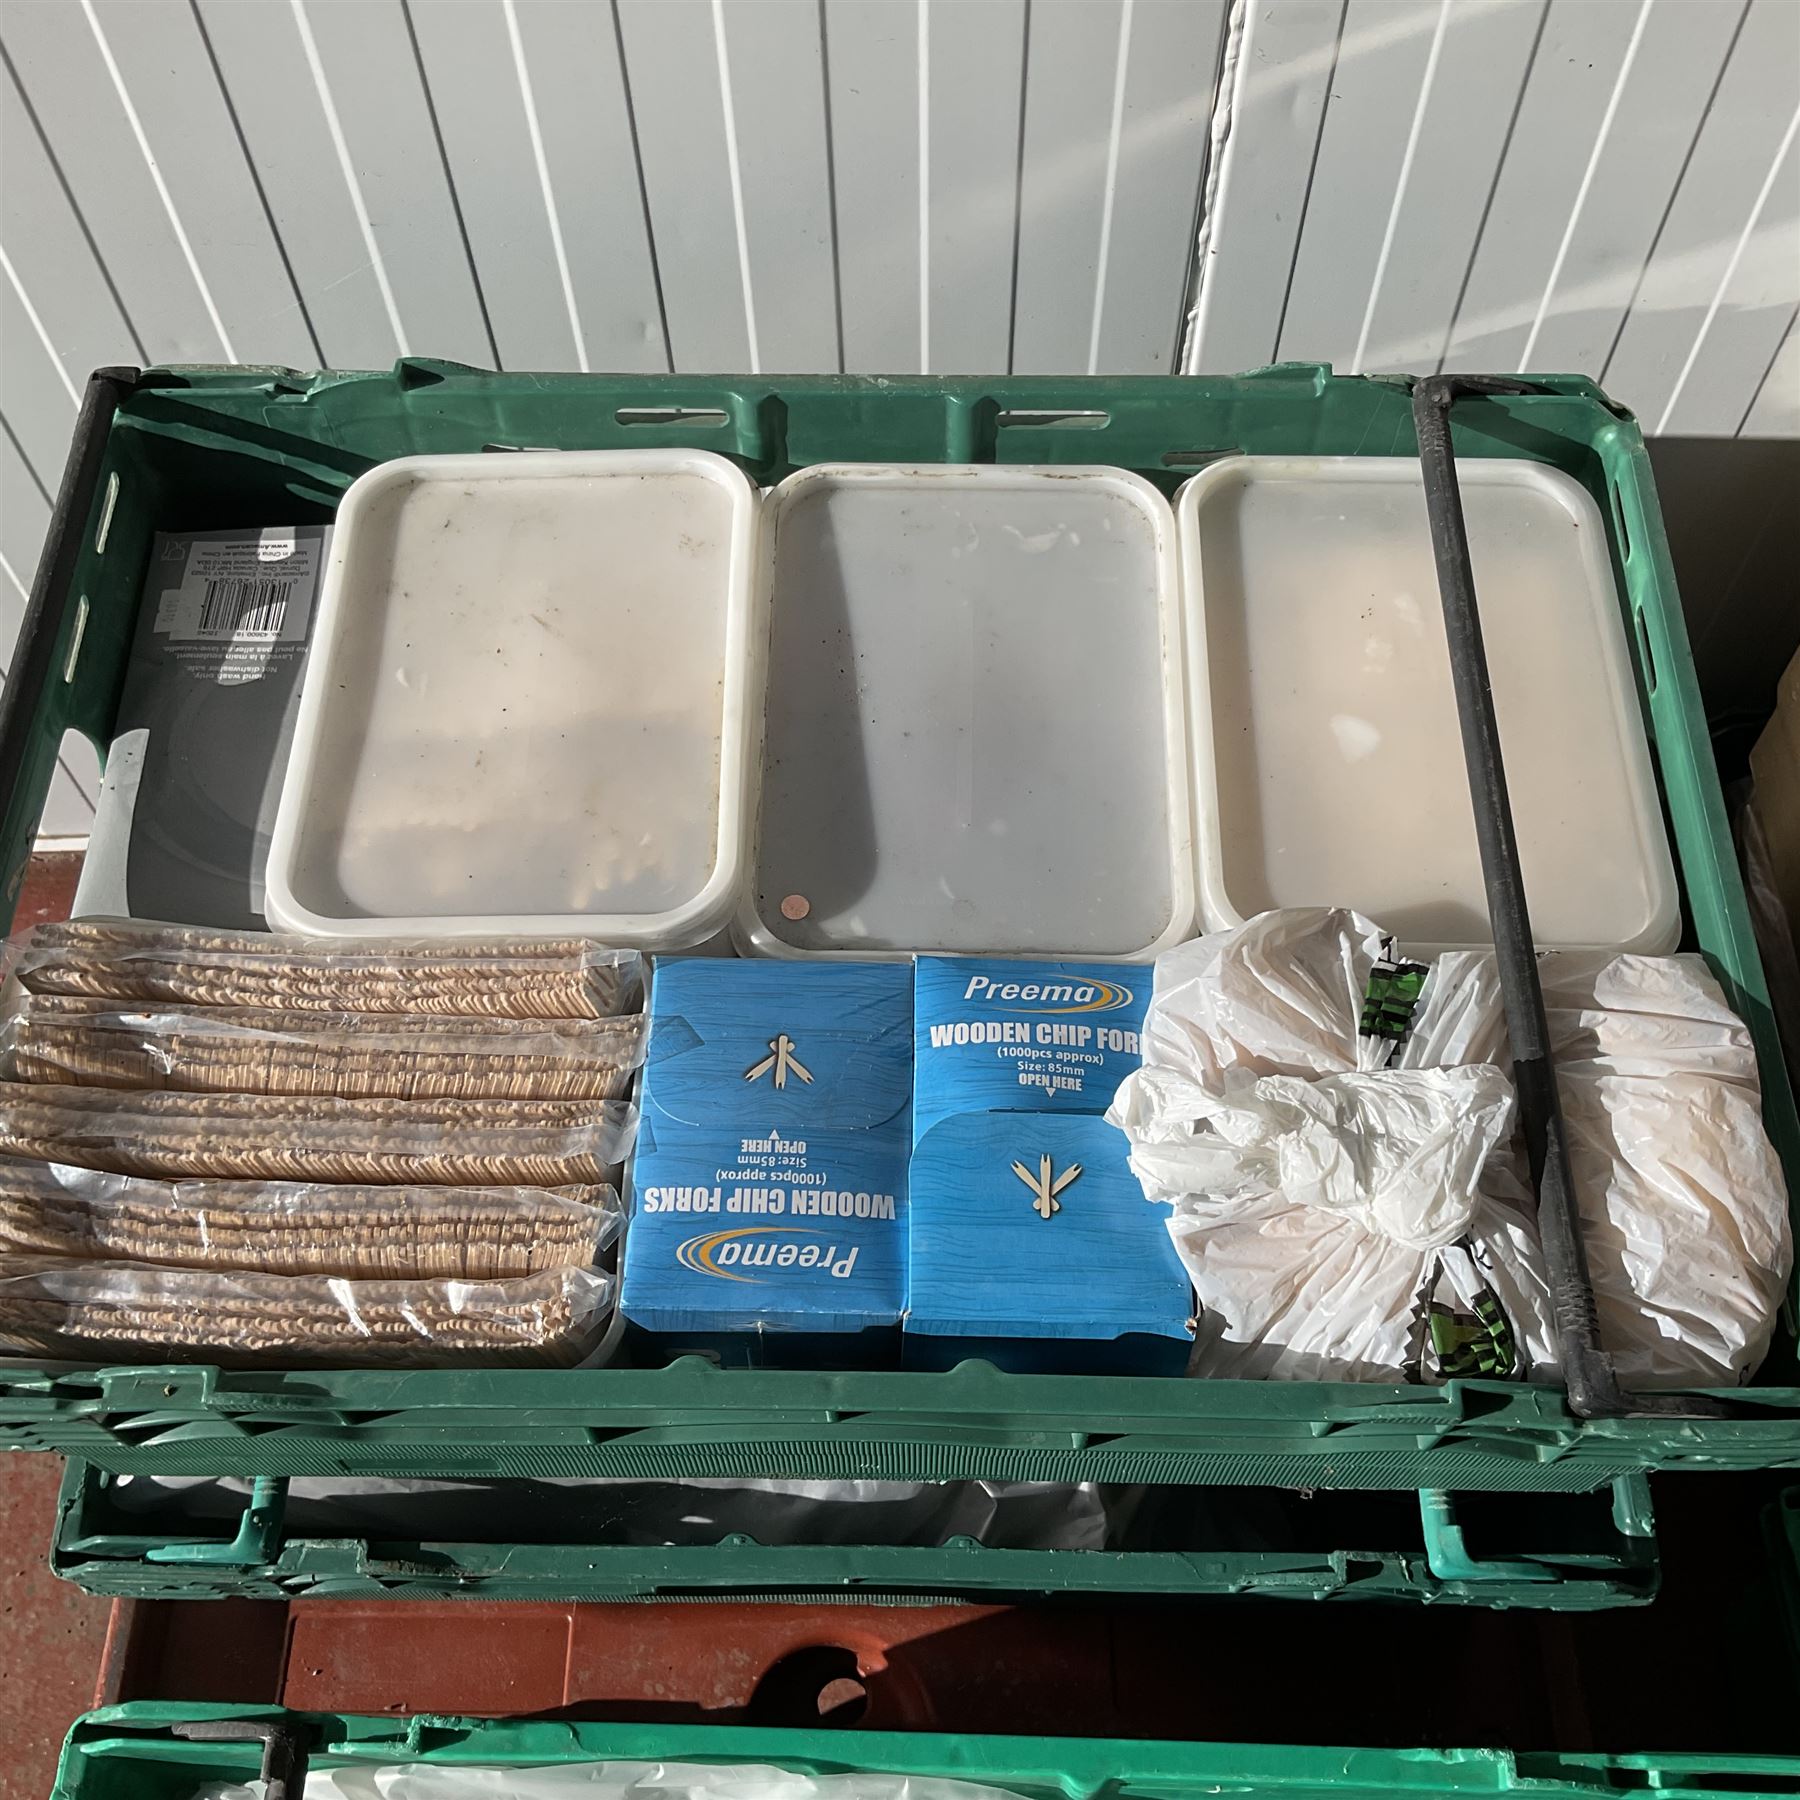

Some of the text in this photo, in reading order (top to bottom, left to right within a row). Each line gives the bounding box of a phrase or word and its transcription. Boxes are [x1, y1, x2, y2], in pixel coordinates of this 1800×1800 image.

[964, 976, 1095, 1003] Preema
[930, 1023, 1030, 1048] WOODEN
[1036, 1023, 1091, 1047] CHIP
[997, 1047, 1104, 1065] (1000pcs approx)
[1017, 1061, 1085, 1076] Size: 85mm
[1018, 1073, 1083, 1091] OPEN HERE
[741, 1139, 807, 1154] OPEN HERE
[737, 1155, 807, 1169] Size: 85mm
[715, 1169, 827, 1186] (1000pcs approx)
[644, 1187, 896, 1220] WOODEN CHIP FORKS
[717, 1243, 860, 1278] Preema
